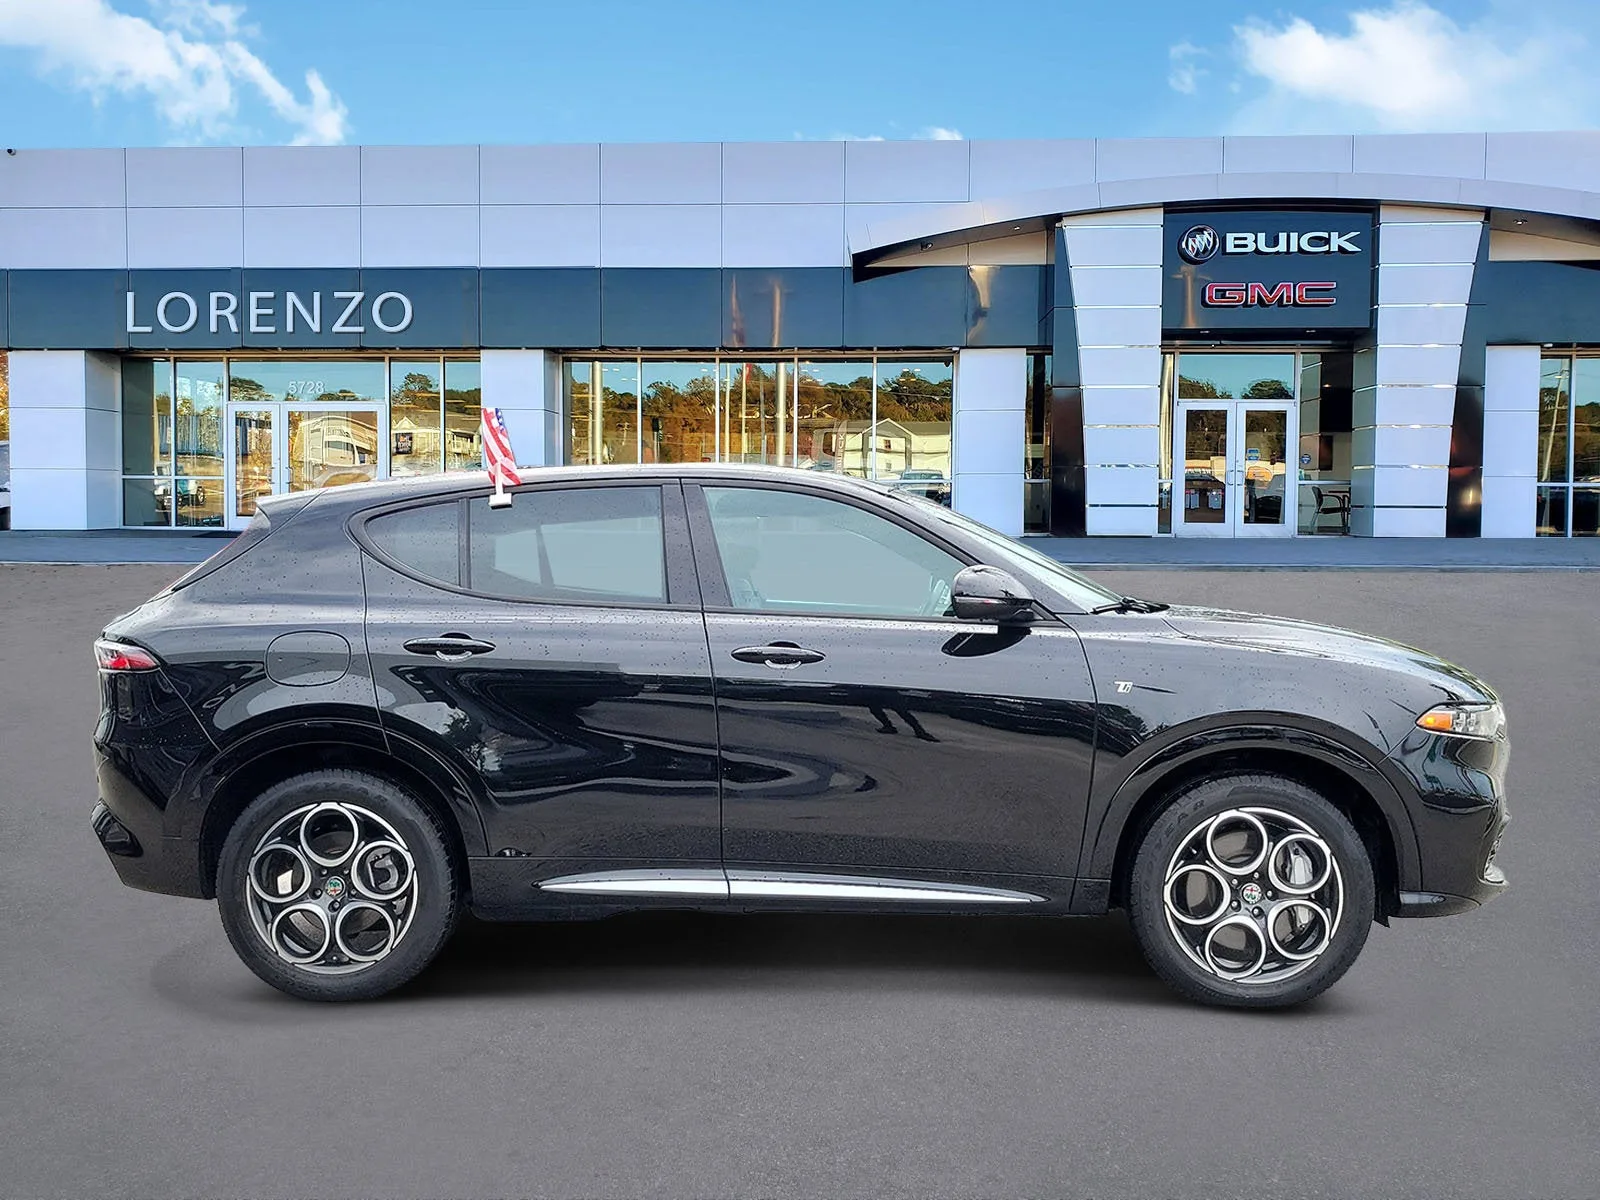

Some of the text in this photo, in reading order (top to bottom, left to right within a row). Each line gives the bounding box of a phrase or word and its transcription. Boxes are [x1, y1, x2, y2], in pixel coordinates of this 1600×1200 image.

[1225, 231, 1362, 253] BUICK
[1205, 281, 1337, 306] GMC
[126, 291, 413, 333] LORENZO
[288, 380, 325, 395] 5728
